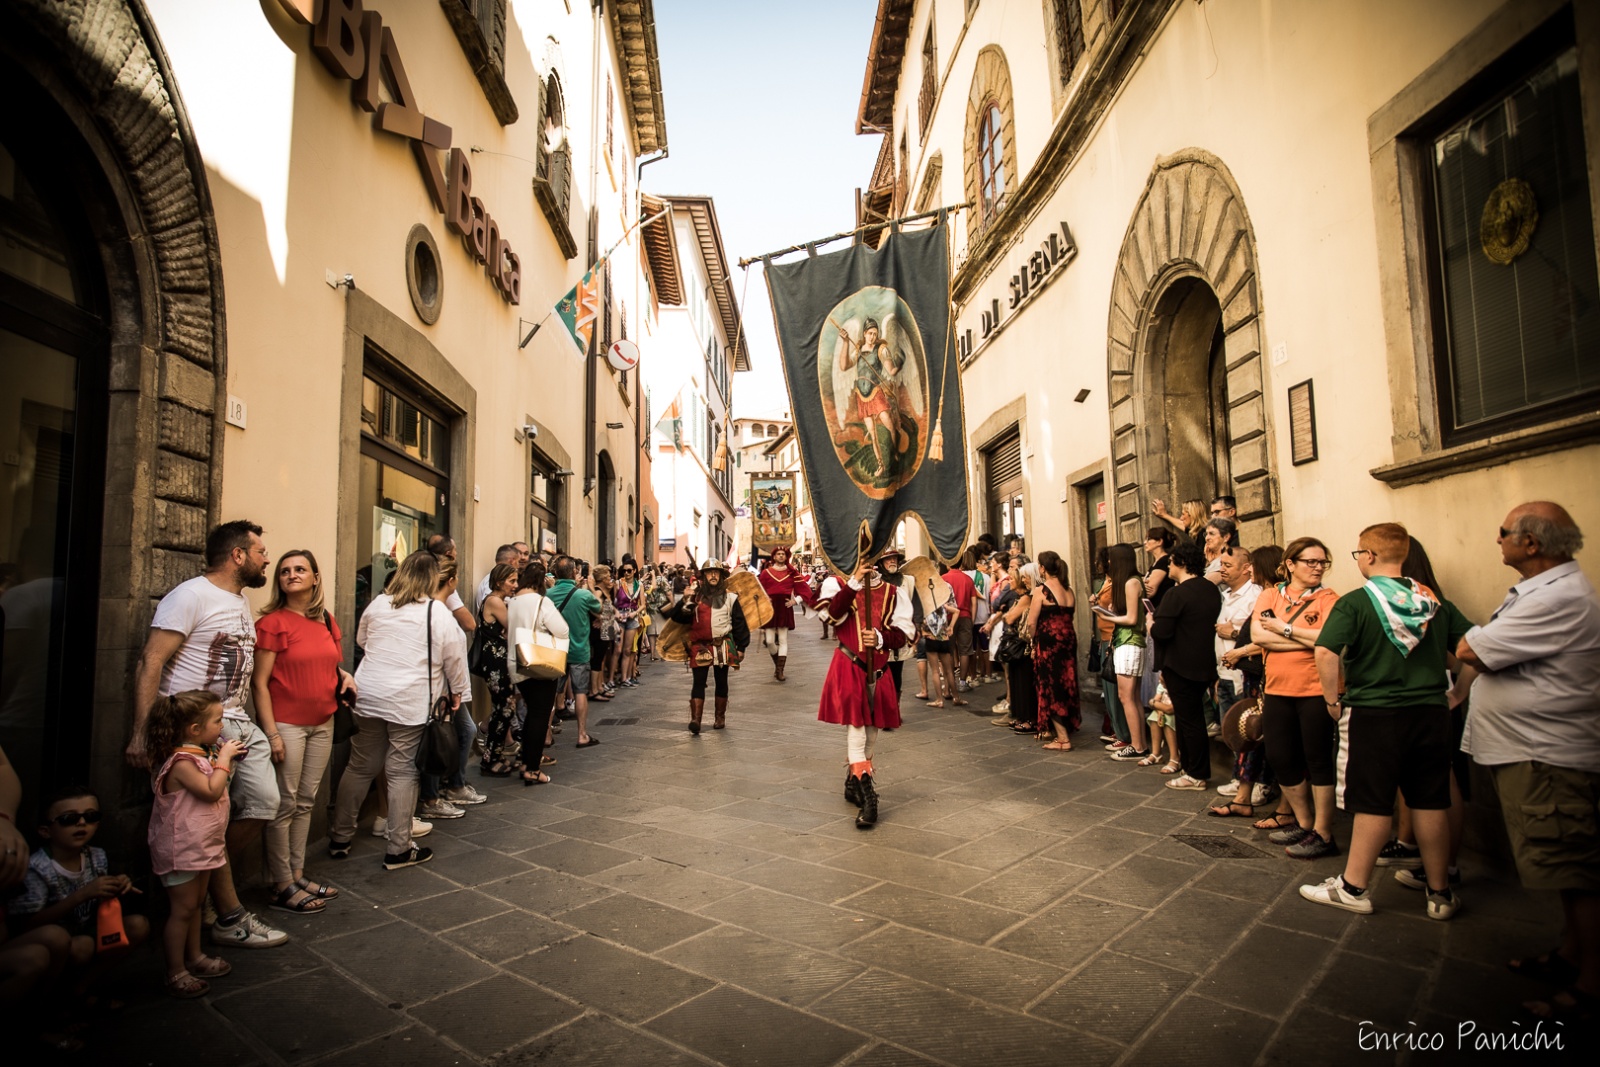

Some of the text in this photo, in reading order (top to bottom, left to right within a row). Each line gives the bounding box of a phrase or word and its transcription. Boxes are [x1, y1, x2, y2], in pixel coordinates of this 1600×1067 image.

[449, 148, 521, 306] Banca
[981, 221, 1076, 339] DI SIENA
[230, 400, 242, 421] 18
